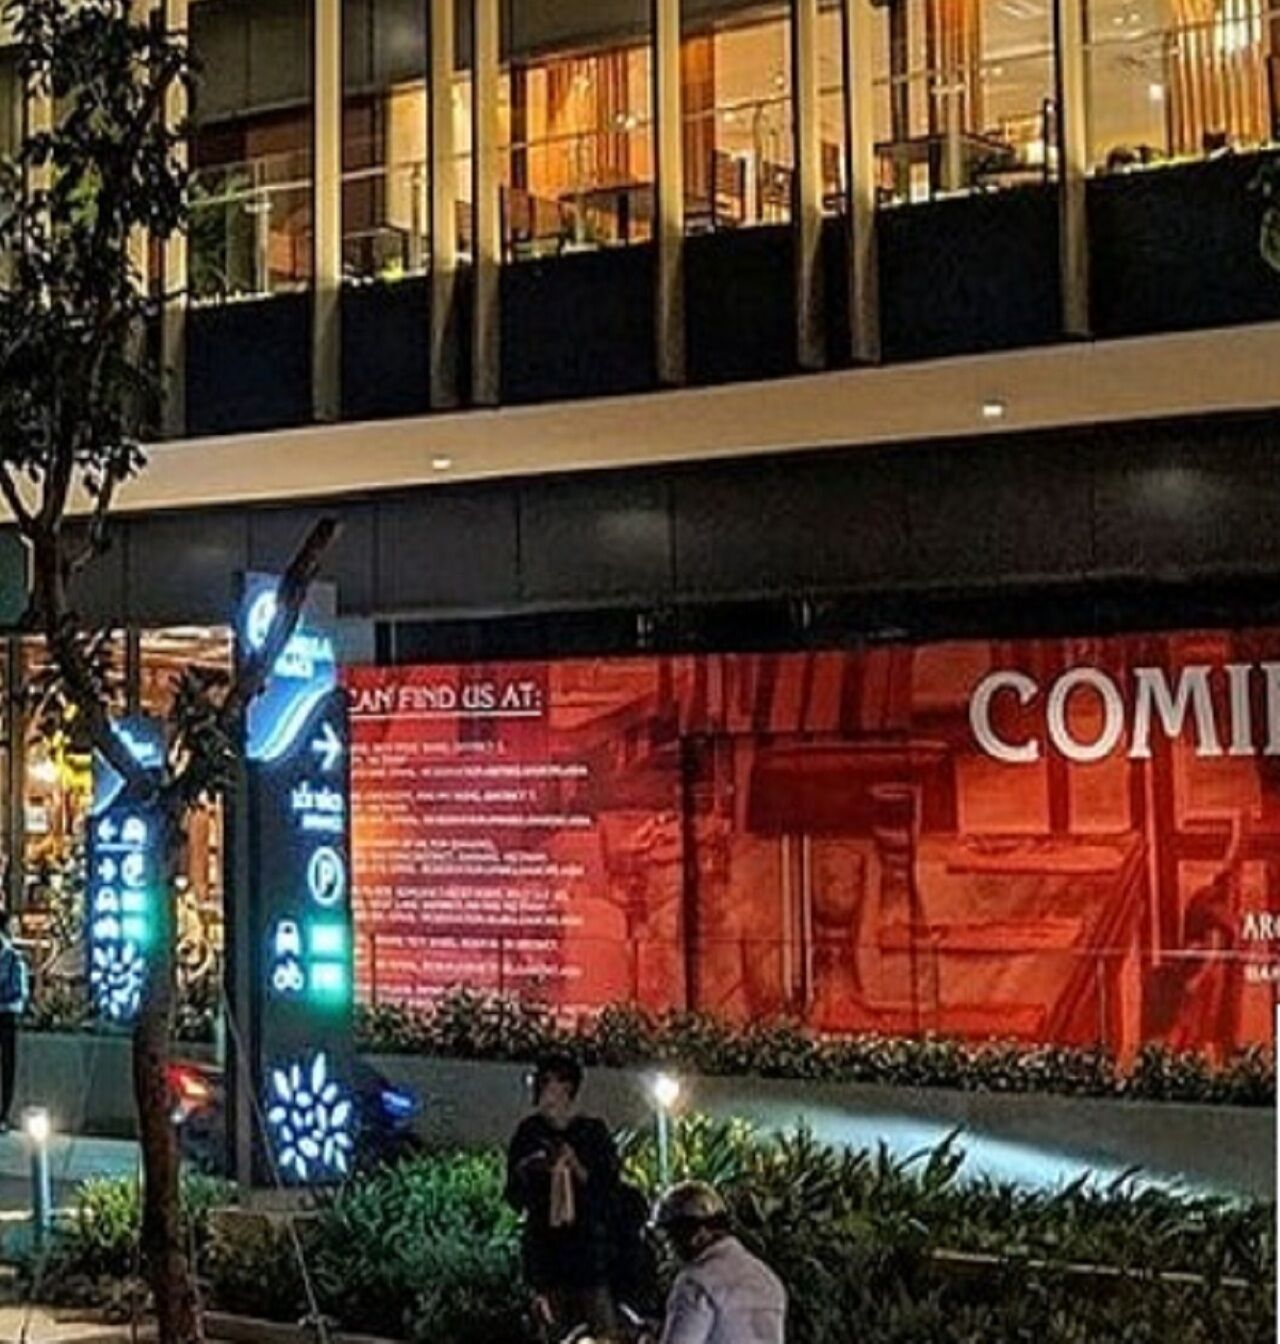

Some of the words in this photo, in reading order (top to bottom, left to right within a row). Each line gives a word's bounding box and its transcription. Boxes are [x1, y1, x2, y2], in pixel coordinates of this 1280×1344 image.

[397, 684, 457, 710] FIND
[461, 683, 495, 708] US
[500, 681, 543, 707] AT:
[969, 662, 1279, 763] COMI
